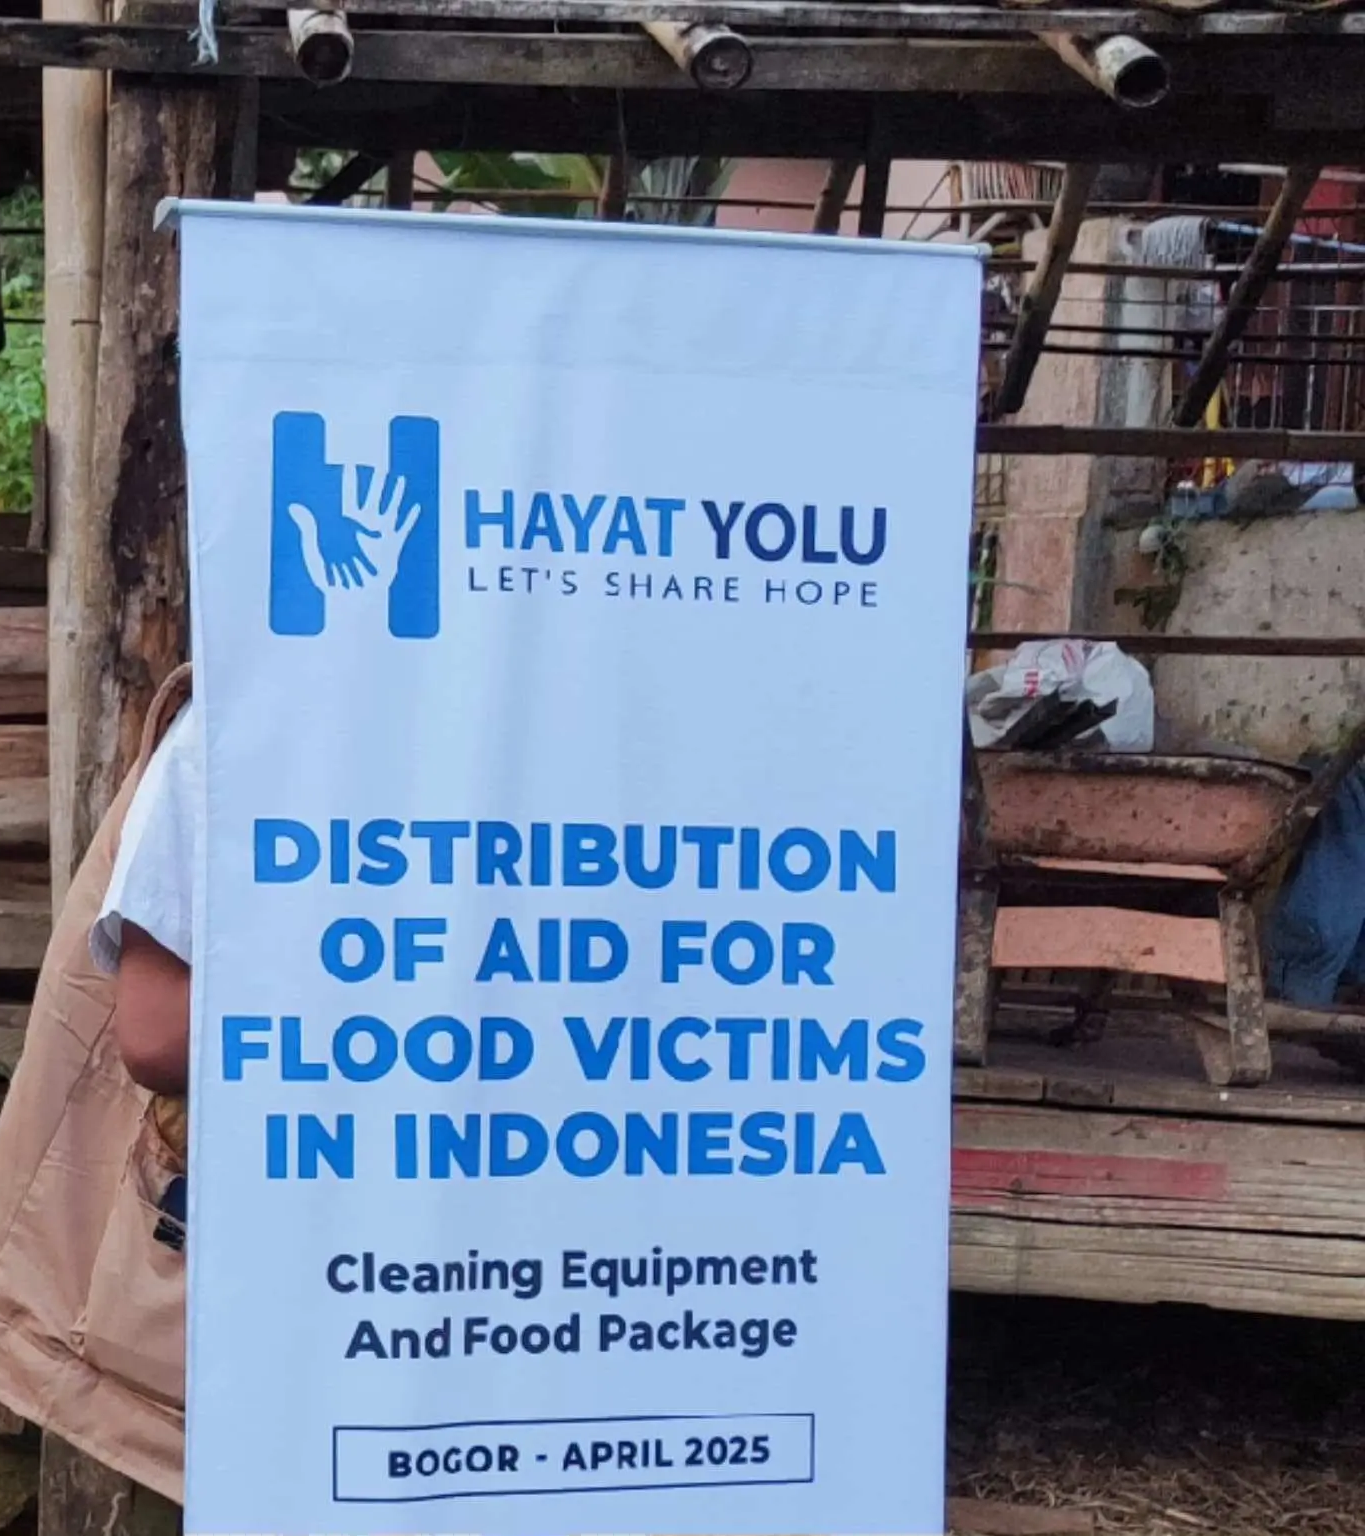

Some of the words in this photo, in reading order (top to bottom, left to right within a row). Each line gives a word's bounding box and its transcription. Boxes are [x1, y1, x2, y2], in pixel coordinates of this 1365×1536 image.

[464, 489, 686, 557] HAYAT
[702, 499, 888, 566] YOLU
[468, 566, 579, 596] LET'S
[605, 571, 741, 603] SHARE
[764, 577, 879, 608] HOPE
[253, 818, 897, 893] DISTRIBUTION
[320, 917, 447, 983] OF
[475, 917, 629, 983] AID
[660, 920, 835, 986] FOR
[221, 1014, 535, 1083] FLOOD
[564, 1016, 927, 1083] VICTIMS
[265, 1112, 354, 1180] IN
[394, 1111, 887, 1180] INDONESIA
[326, 1249, 543, 1300] Cleaning
[561, 1246, 818, 1304] Equipment
[344, 1318, 451, 1359] And
[463, 1314, 580, 1357] Food
[598, 1311, 798, 1358] Package
[387, 1444, 519, 1478] BOGOR
[562, 1439, 673, 1472] APRIL
[684, 1435, 770, 1466] 2025
